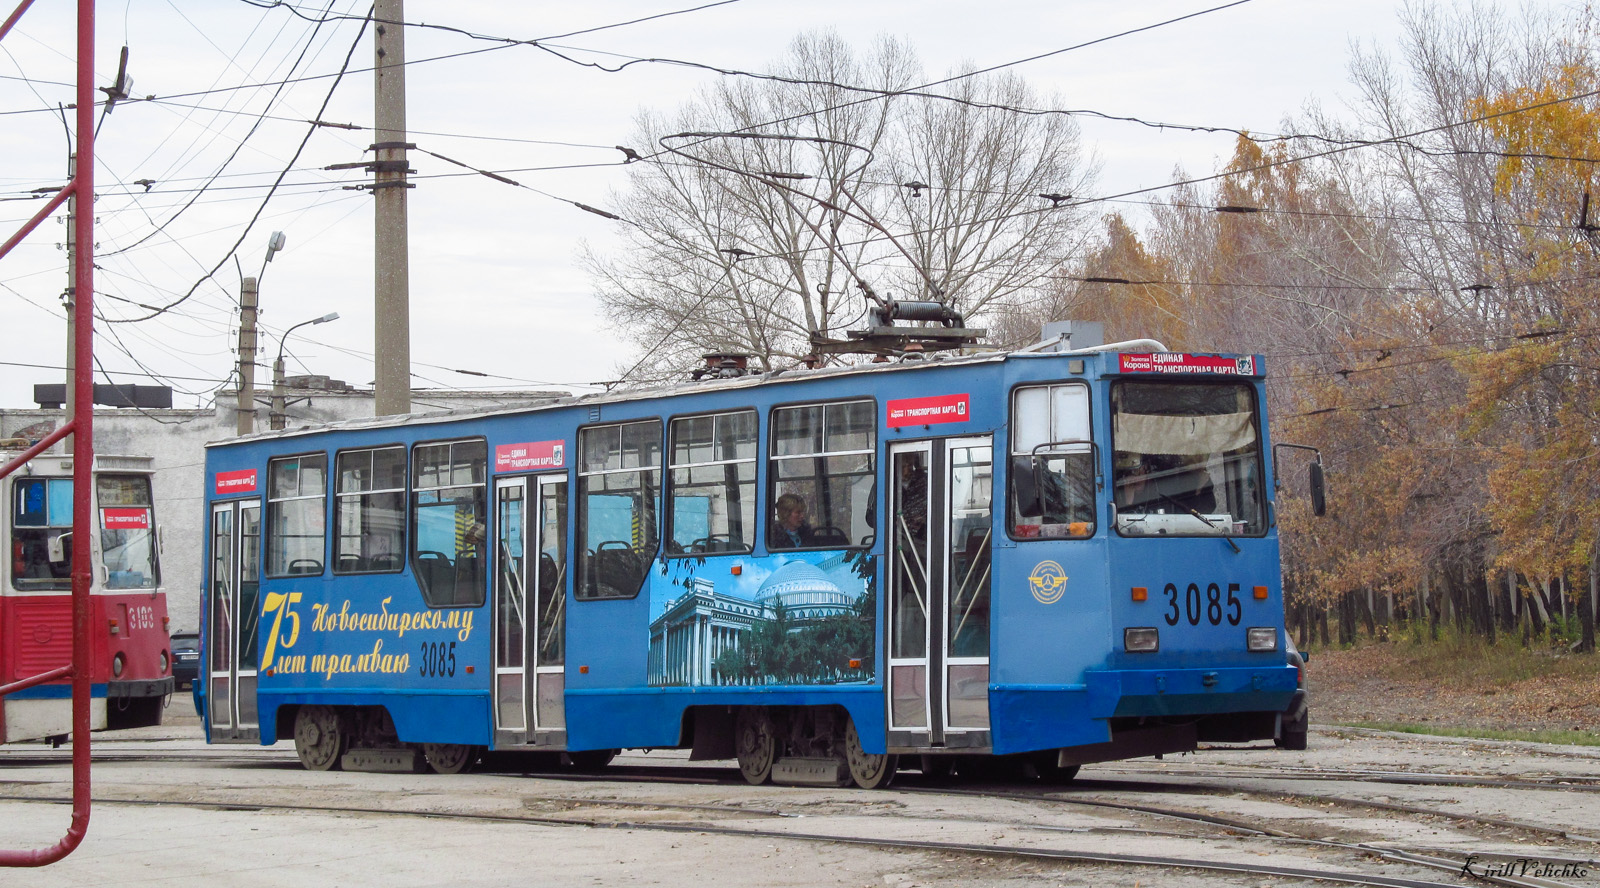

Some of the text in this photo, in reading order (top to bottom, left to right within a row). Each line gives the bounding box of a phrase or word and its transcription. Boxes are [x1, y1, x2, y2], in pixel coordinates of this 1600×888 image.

[1123, 361, 1150, 370] Корона
[1152, 354, 1184, 364] ЕДИНАЯ
[907, 405, 956, 416] ТРАНСПОРТНАЯ КАРТА
[511, 457, 553, 467] ТРАНСПОРТНАЯ КАРТА
[512, 449, 526, 458] ЕДИНАЯ
[1163, 582, 1242, 626] 3085
[129, 605, 154, 630] 3103
[260, 592, 474, 672] 75 Новосибирскому
[273, 639, 411, 681] лет трамваю
[419, 641, 457, 678] 3085
